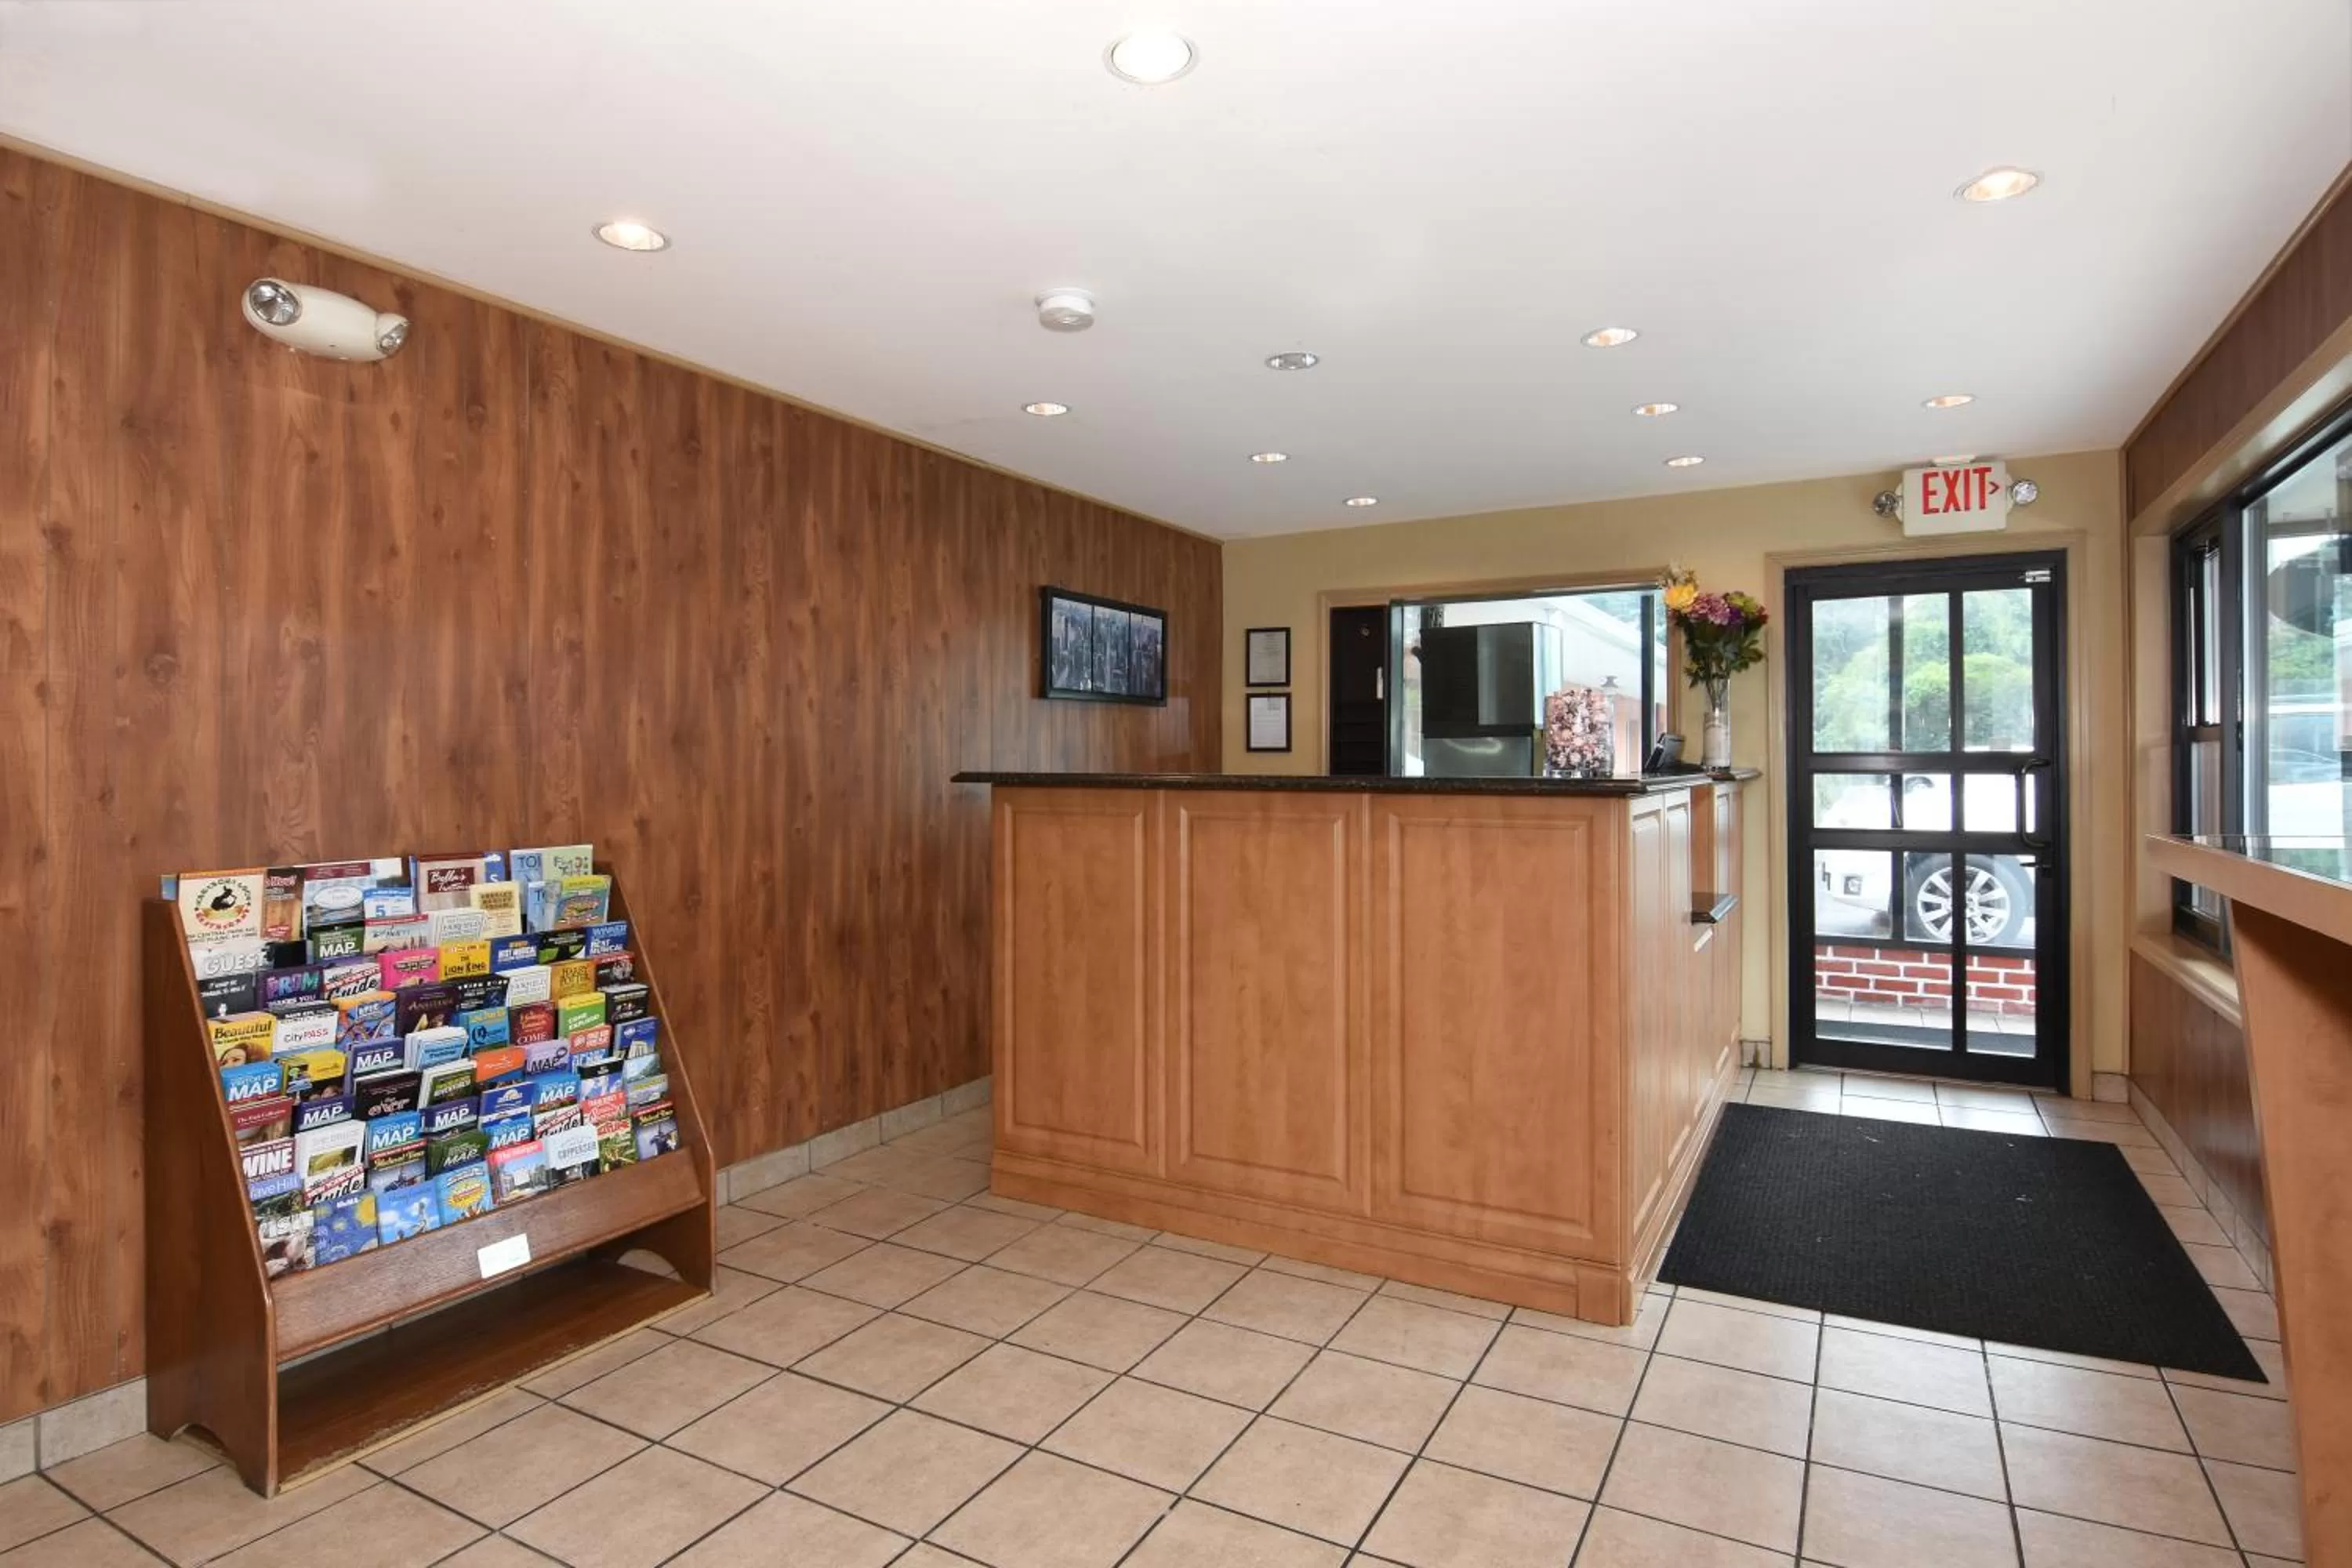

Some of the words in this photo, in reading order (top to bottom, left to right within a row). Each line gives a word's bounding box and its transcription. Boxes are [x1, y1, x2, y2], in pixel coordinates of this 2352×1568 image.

[1922, 466, 1992, 515] EXIT
[375, 904, 387, 917] 5
[319, 942, 355, 958] MAP
[203, 951, 268, 977] GUEST
[444, 964, 463, 977] LION
[465, 961, 487, 974] KING
[267, 971, 320, 1000] PROM
[214, 1020, 272, 1040] Beautiful
[517, 1032, 547, 1045] COME
[355, 1051, 395, 1069] MAP
[531, 1058, 560, 1073] MAP
[228, 1078, 278, 1102] MAP
[539, 1085, 575, 1105] MAP
[303, 1105, 343, 1126] MAP
[434, 1108, 470, 1127] MAP
[372, 1127, 416, 1150] MAP
[492, 1127, 529, 1149] MAP
[444, 1148, 478, 1167] MAP
[277, 1176, 298, 1190] Hill
